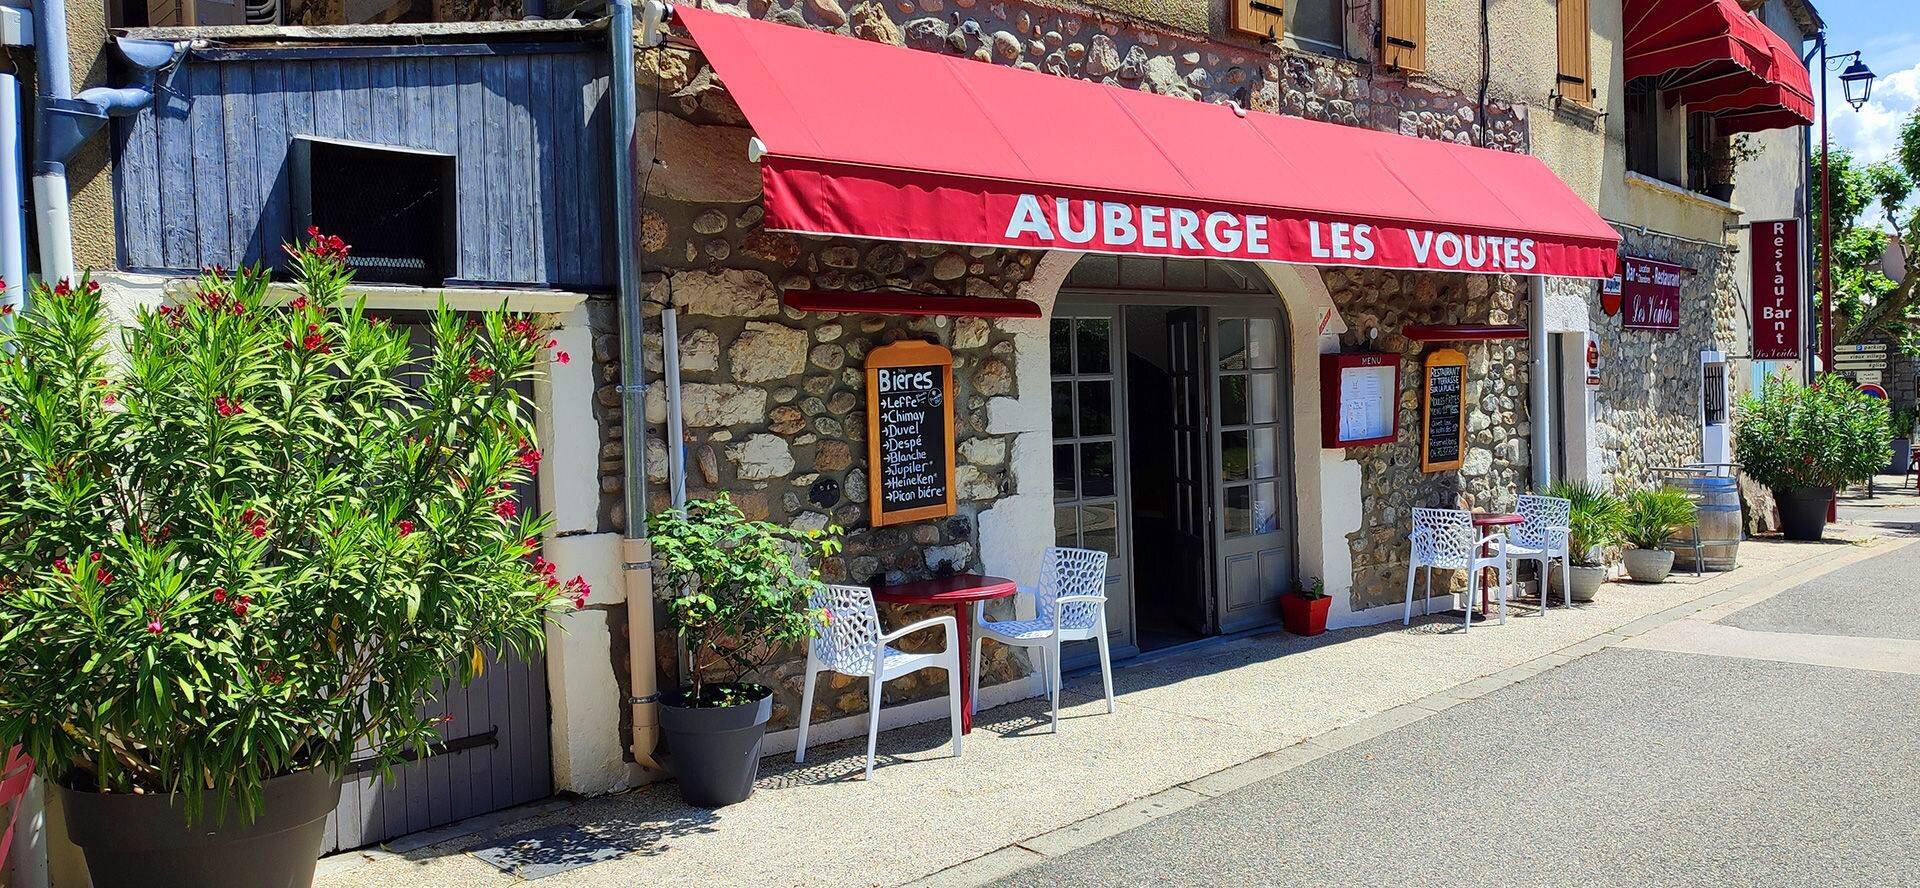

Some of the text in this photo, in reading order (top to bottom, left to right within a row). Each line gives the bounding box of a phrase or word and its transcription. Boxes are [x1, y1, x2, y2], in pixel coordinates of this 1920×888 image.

[1004, 193, 1537, 271] AUBERGE LES VOUTES
[1626, 262, 1679, 286] Bar Restaurant
[1763, 306, 1792, 320] Bar
[1361, 357, 1382, 365] MENU
[887, 396, 918, 408] Leffe
[888, 410, 925, 424] Chimay
[888, 421, 919, 438] Duvel
[889, 434, 923, 452] Despé
[890, 449, 927, 464] Blanche
[892, 490, 916, 503] Picon
